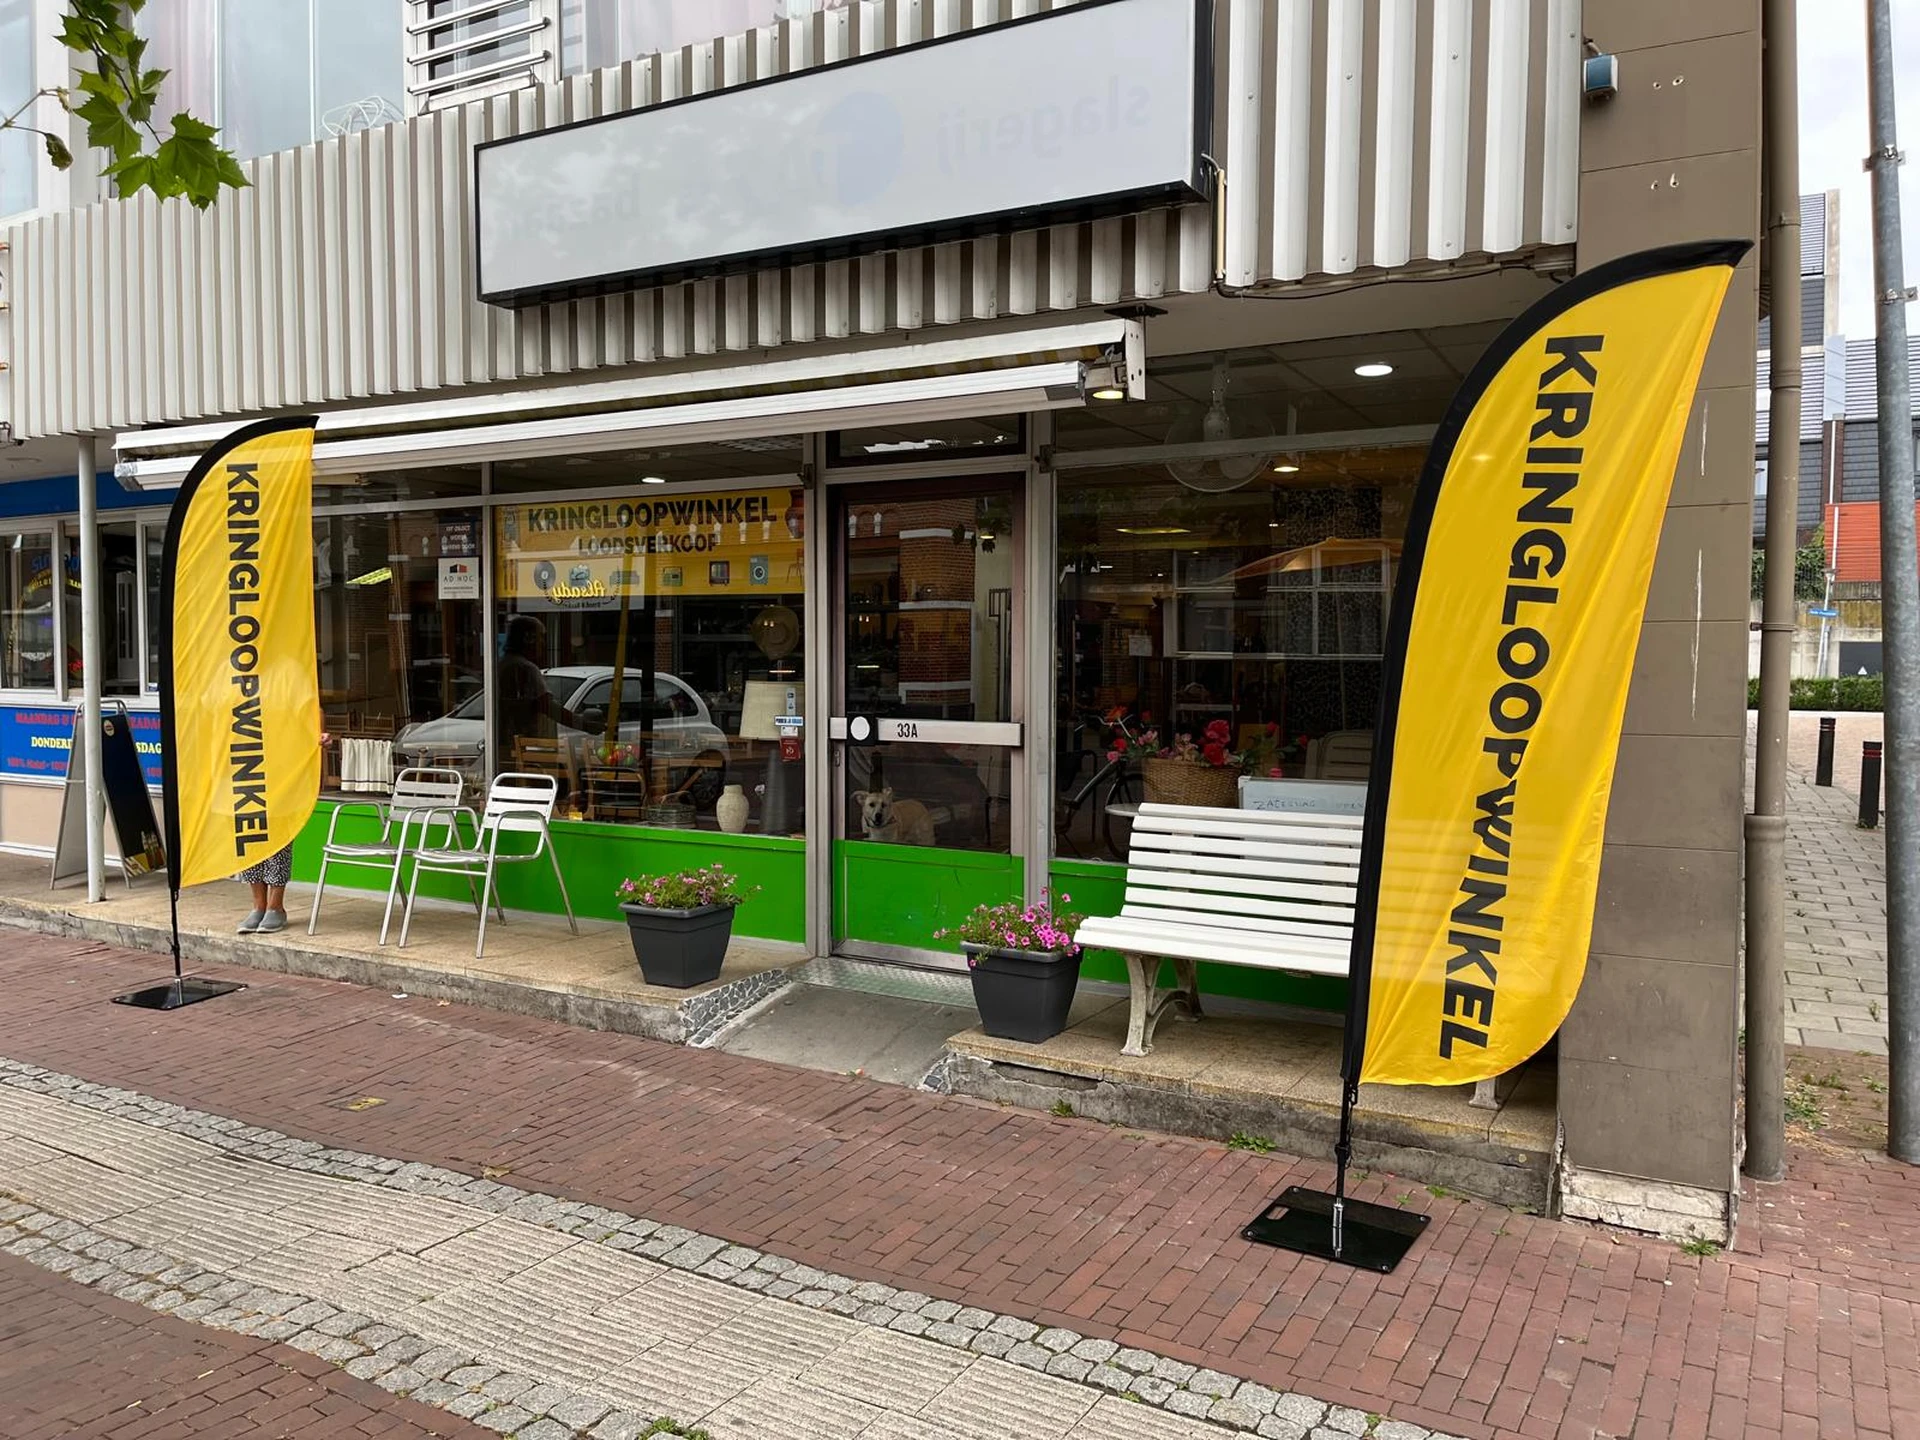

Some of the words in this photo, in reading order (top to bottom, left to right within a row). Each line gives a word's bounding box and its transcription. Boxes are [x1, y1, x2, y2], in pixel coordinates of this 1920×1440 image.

[528, 496, 777, 532] KRINGLOOPWINKEL
[578, 532, 717, 556] LOODSVERKOOP
[227, 463, 269, 857] KRINGLOOPWINKEL
[1439, 334, 1604, 1060] KRINGLOOPWINKEL
[897, 722, 918, 738] 33A
[136, 742, 162, 754] SDAG
